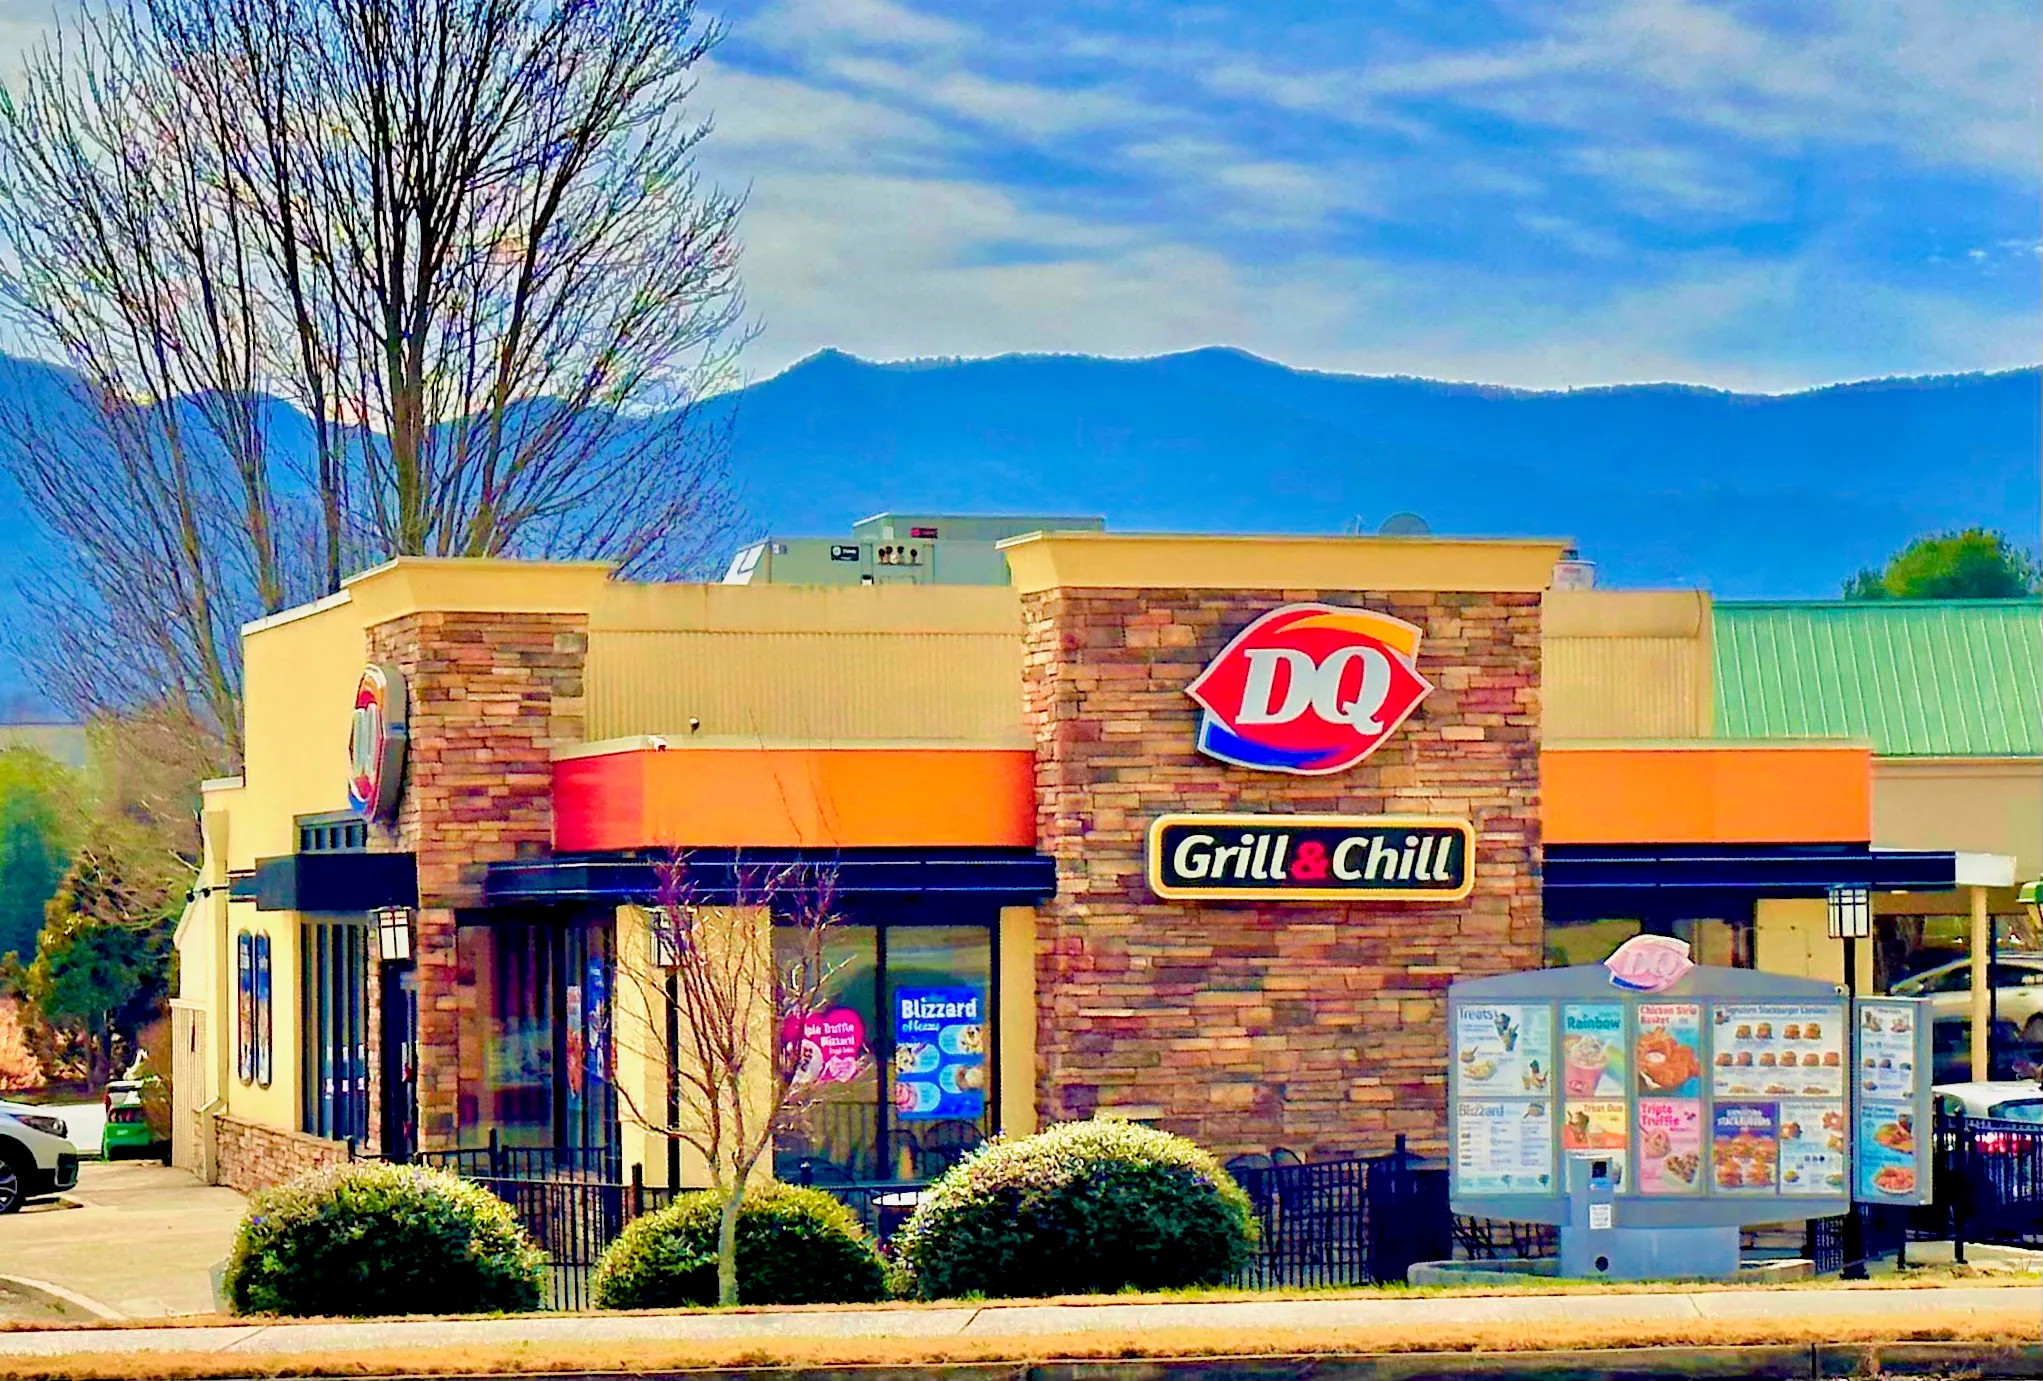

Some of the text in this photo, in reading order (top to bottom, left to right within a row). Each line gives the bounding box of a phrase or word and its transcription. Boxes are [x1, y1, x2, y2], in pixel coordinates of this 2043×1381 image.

[1235, 646, 1392, 736] DQ
[1173, 834, 1452, 881] Grill & Chill
[901, 997, 978, 1019] Blizzard
[1459, 1008, 1493, 1020] Treats
[1567, 1015, 1621, 1030] Rainbow
[1459, 1104, 1504, 1117] Blizzard
[1641, 1104, 1673, 1116] Triple
[1641, 1115, 1680, 1125] Truffle
